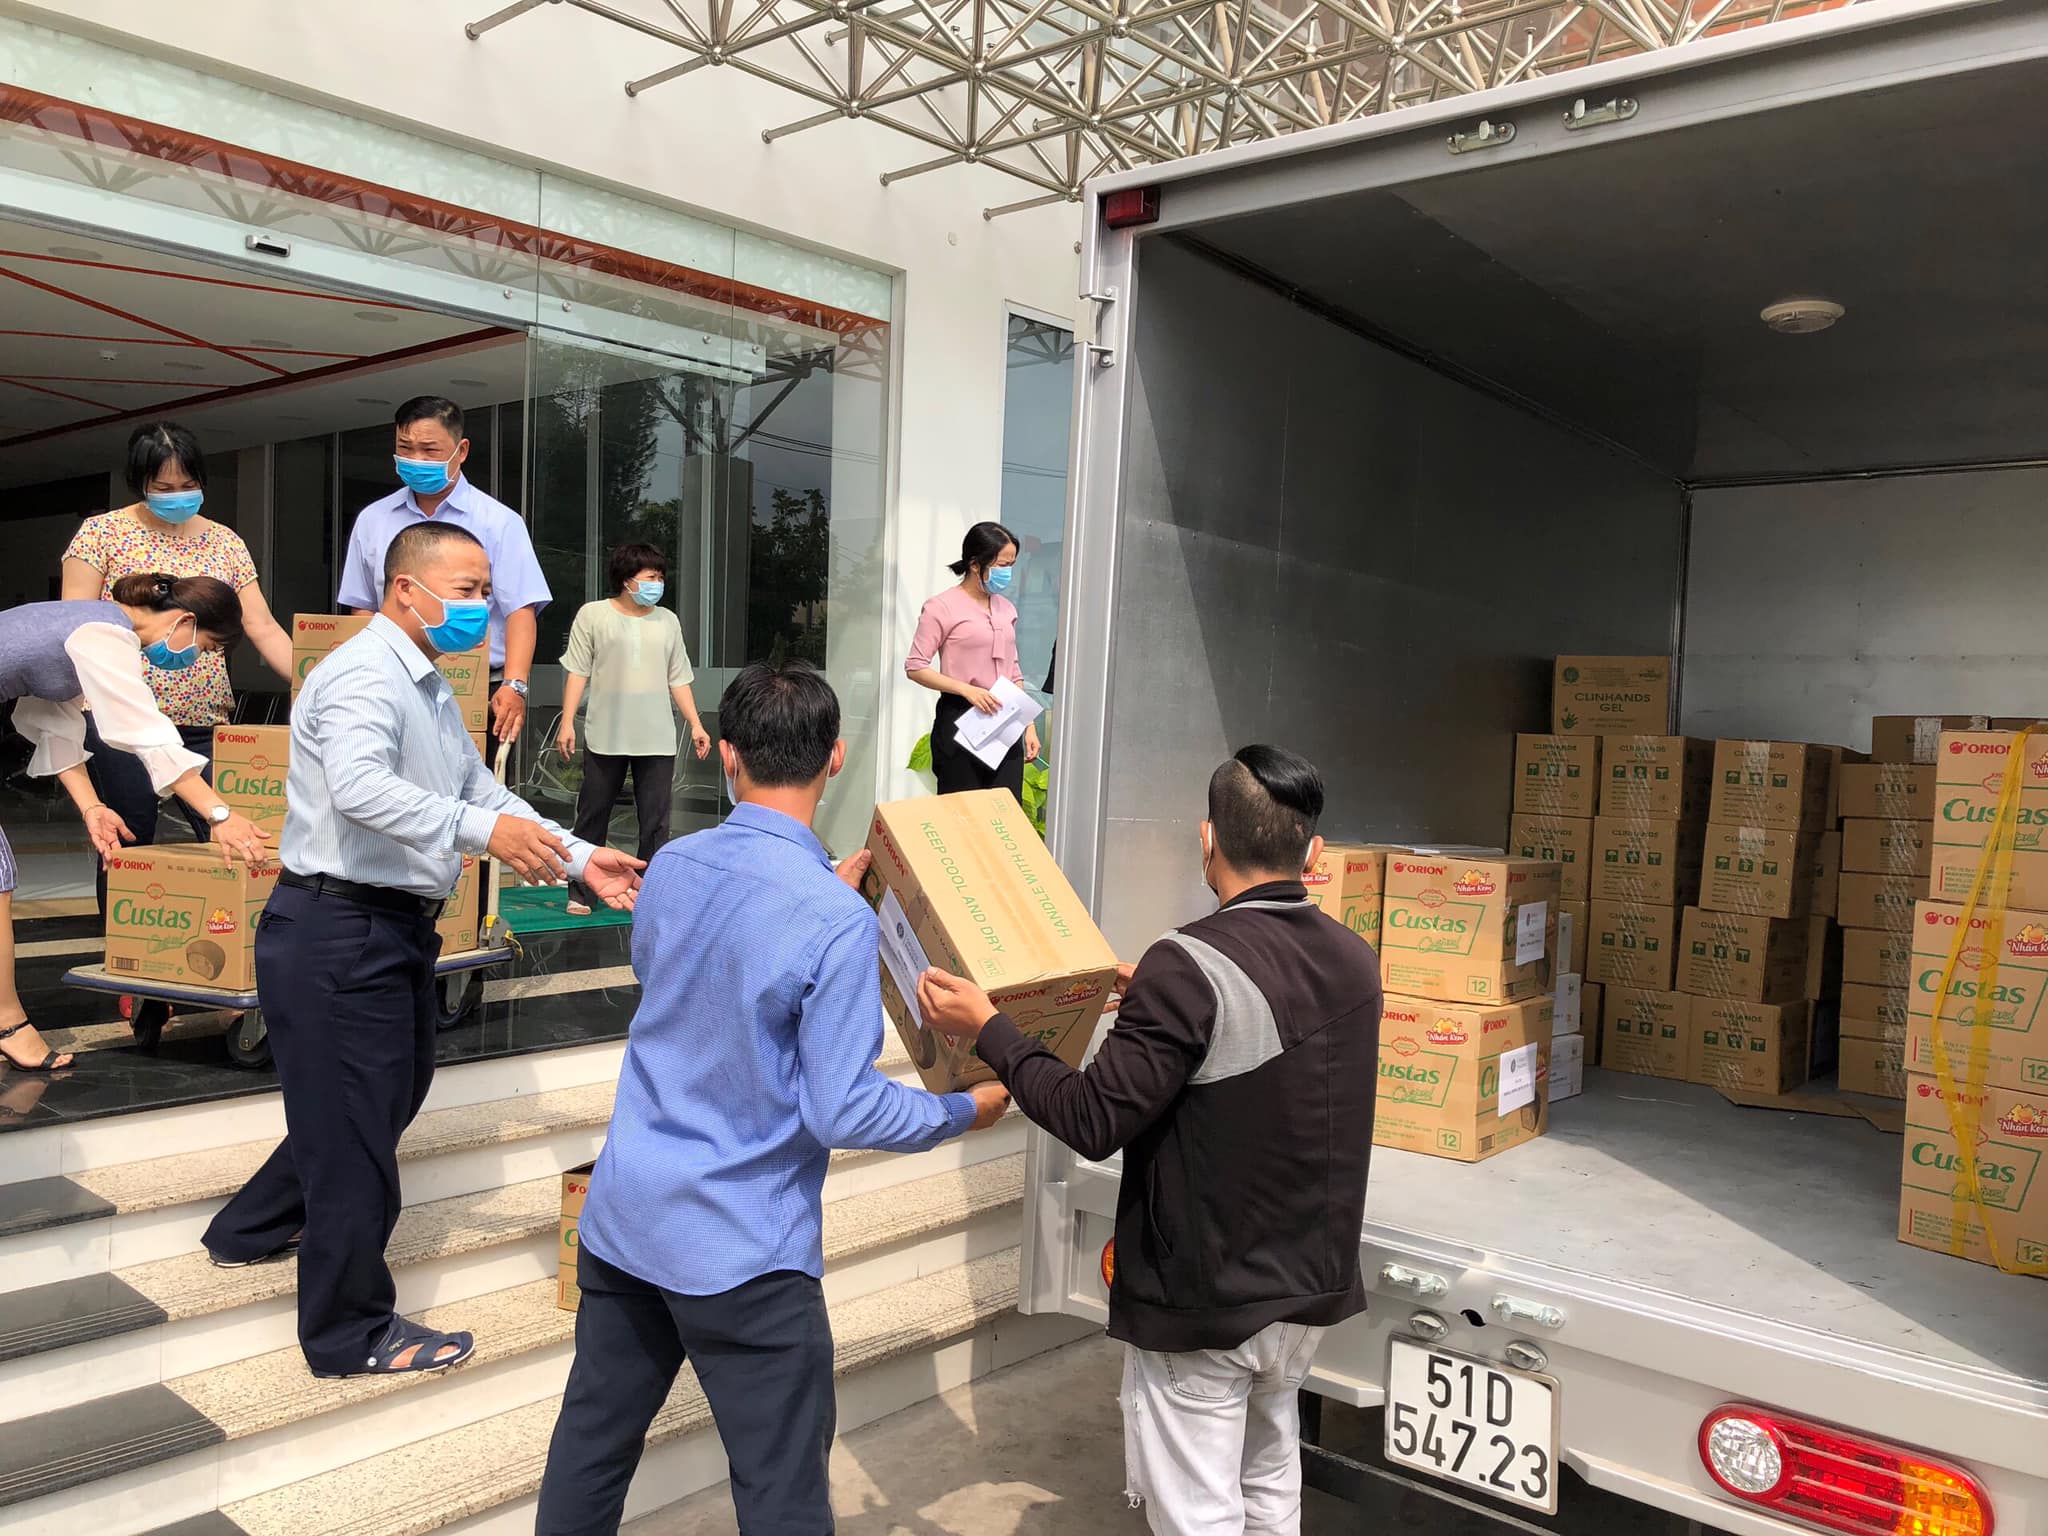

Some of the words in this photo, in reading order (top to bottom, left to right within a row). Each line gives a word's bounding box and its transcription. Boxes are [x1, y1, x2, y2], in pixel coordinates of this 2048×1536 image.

[309, 622, 336, 631] ORION
[440, 666, 471, 680] ustas
[1574, 692, 1651, 702] CLINHANDS
[1600, 703, 1625, 712] GEL
[473, 713, 482, 723] 12
[228, 734, 257, 744] ORION
[1967, 744, 2011, 755] ORIO
[991, 818, 1018, 852] CARE
[882, 834, 906, 877] ORION
[124, 860, 153, 871] ORION
[1011, 853, 1039, 885] WITH
[1407, 864, 1444, 876] ORION
[920, 821, 947, 854] KEEP
[941, 856, 968, 893] COOL
[962, 895, 987, 923] AND
[980, 926, 1006, 953] DRY
[112, 898, 193, 930] Custas
[1031, 885, 1072, 939] HANDLE
[1344, 905, 1380, 933] Custa
[1389, 908, 1468, 934] Custas
[1943, 914, 1993, 930] OON
[461, 933, 470, 942] 12
[1471, 979, 1487, 993] 12
[1002, 988, 1047, 1002] ORION
[1378, 1062, 1441, 1085] ustas
[2027, 1063, 2048, 1081] 12
[1441, 1133, 1457, 1147] 12
[1911, 1142, 2017, 1183] Cusas
[2023, 1245, 2043, 1263] 12
[1428, 1354, 1513, 1427] 51D
[1393, 1402, 1548, 1499] 547.23
